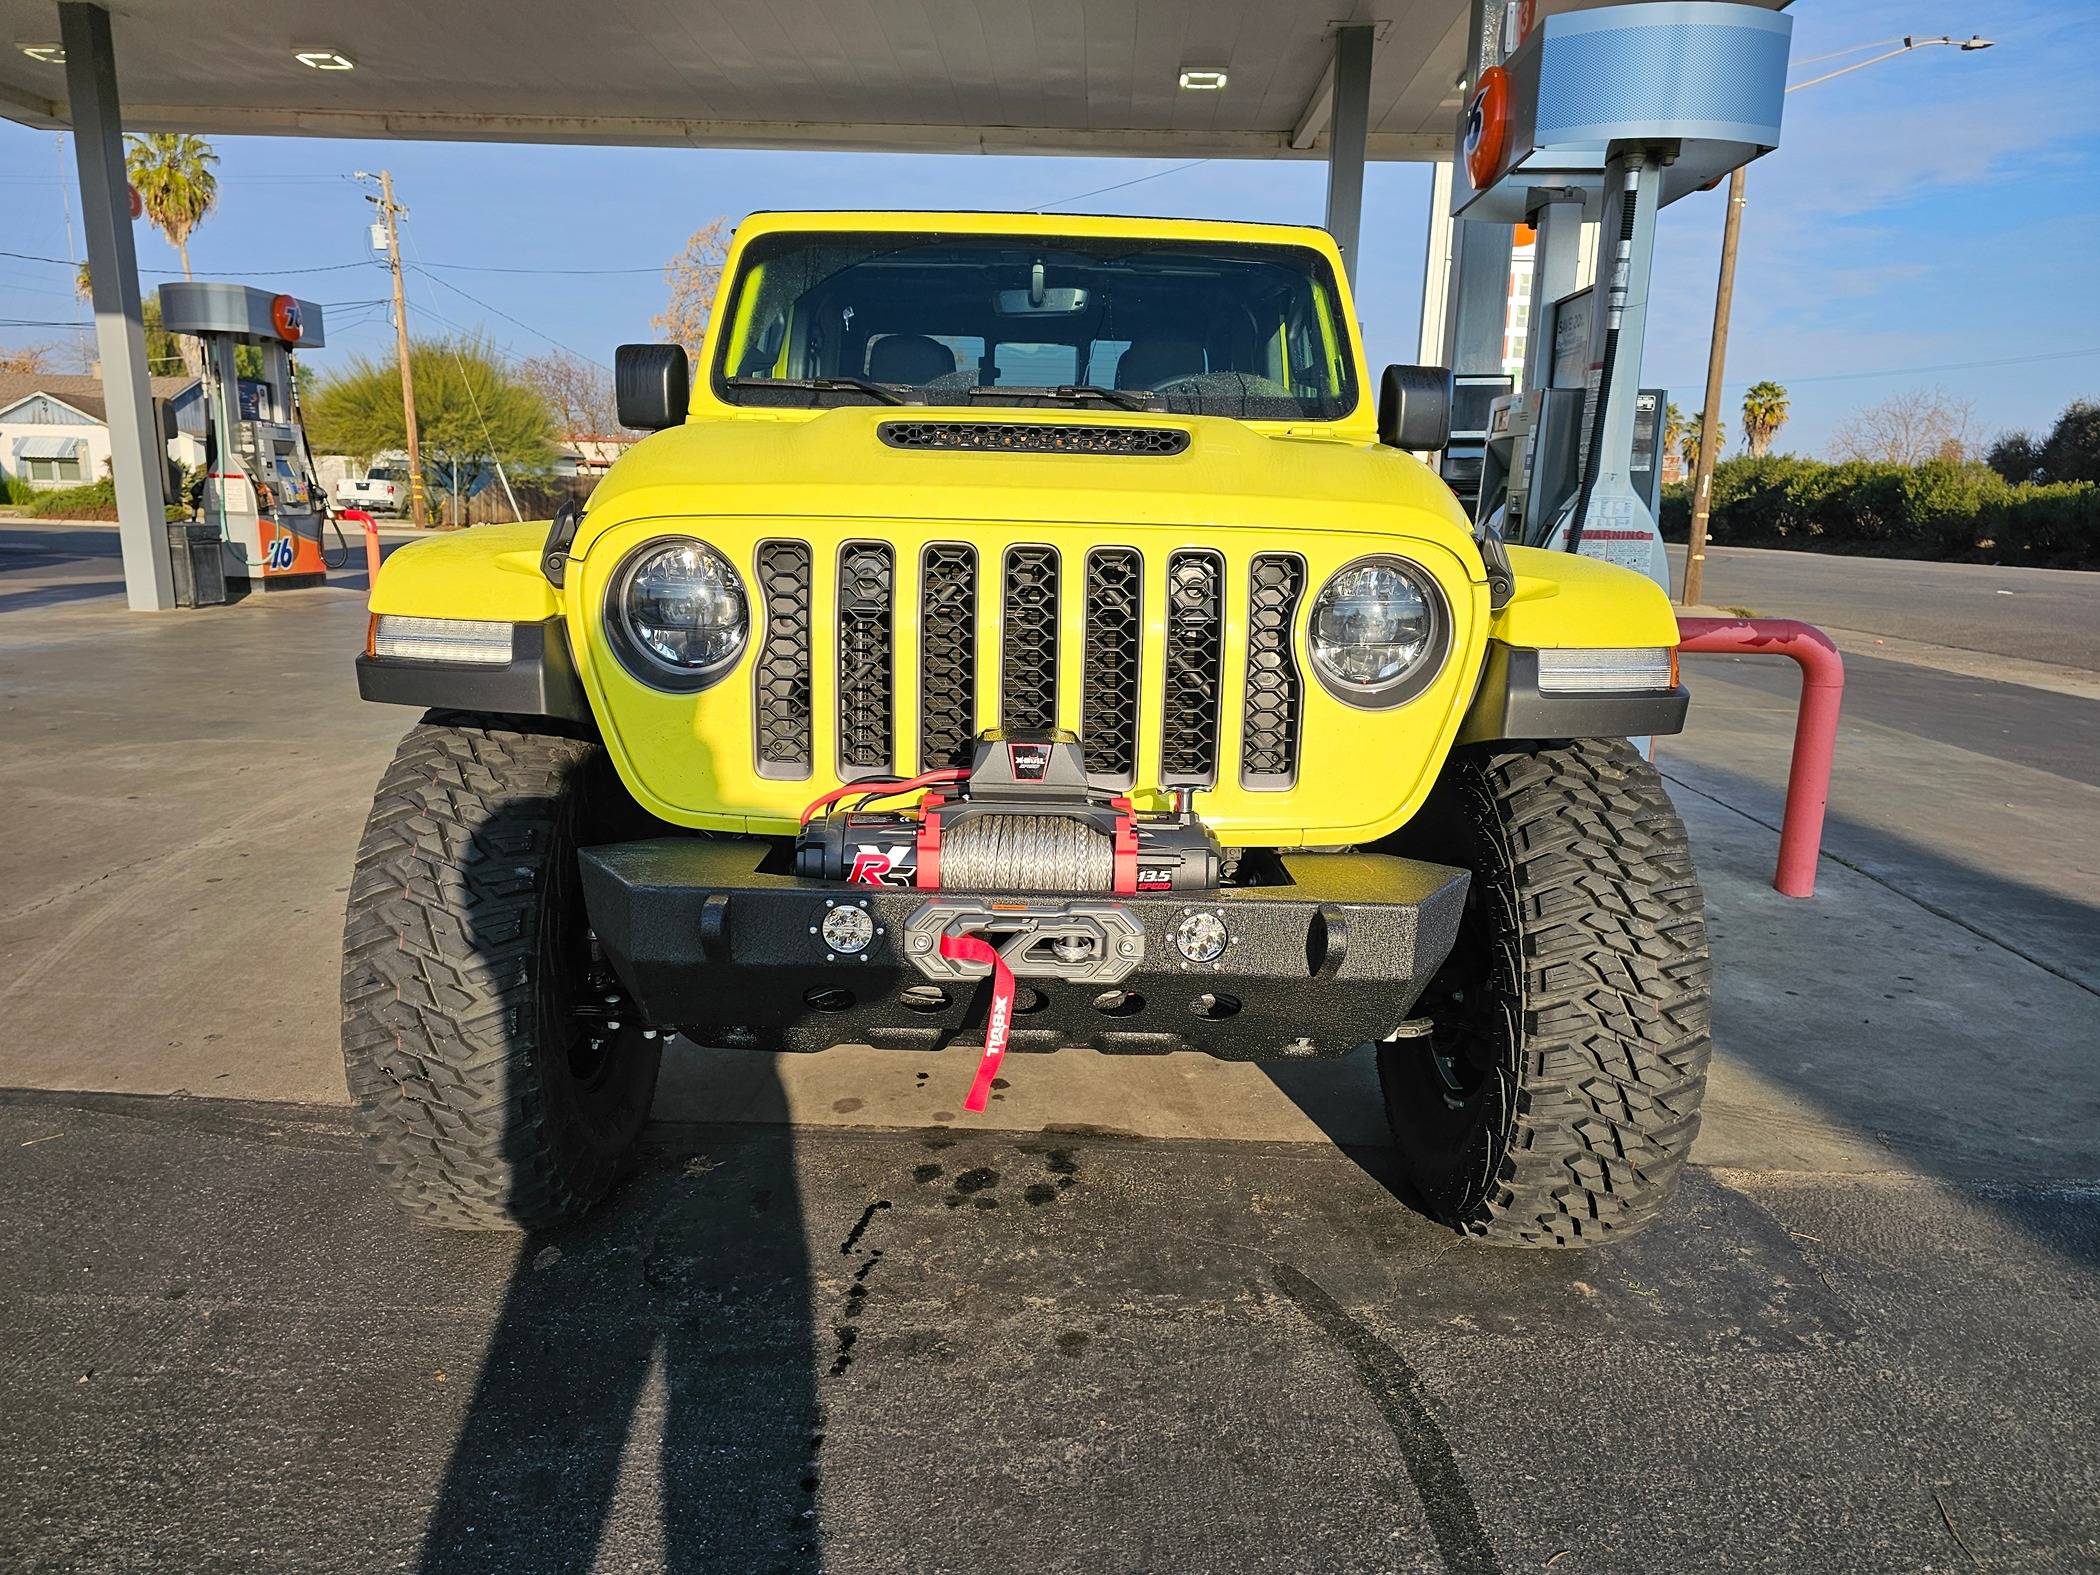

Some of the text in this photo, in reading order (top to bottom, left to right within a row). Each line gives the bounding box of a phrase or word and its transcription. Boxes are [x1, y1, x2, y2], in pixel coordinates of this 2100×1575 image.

[1582, 530, 1644, 540] WARNING
[268, 536, 293, 570] 76
[1137, 870, 1172, 882] 13.5
[1137, 882, 1172, 890] SPEED
[986, 995, 1009, 1057] X-BULL
